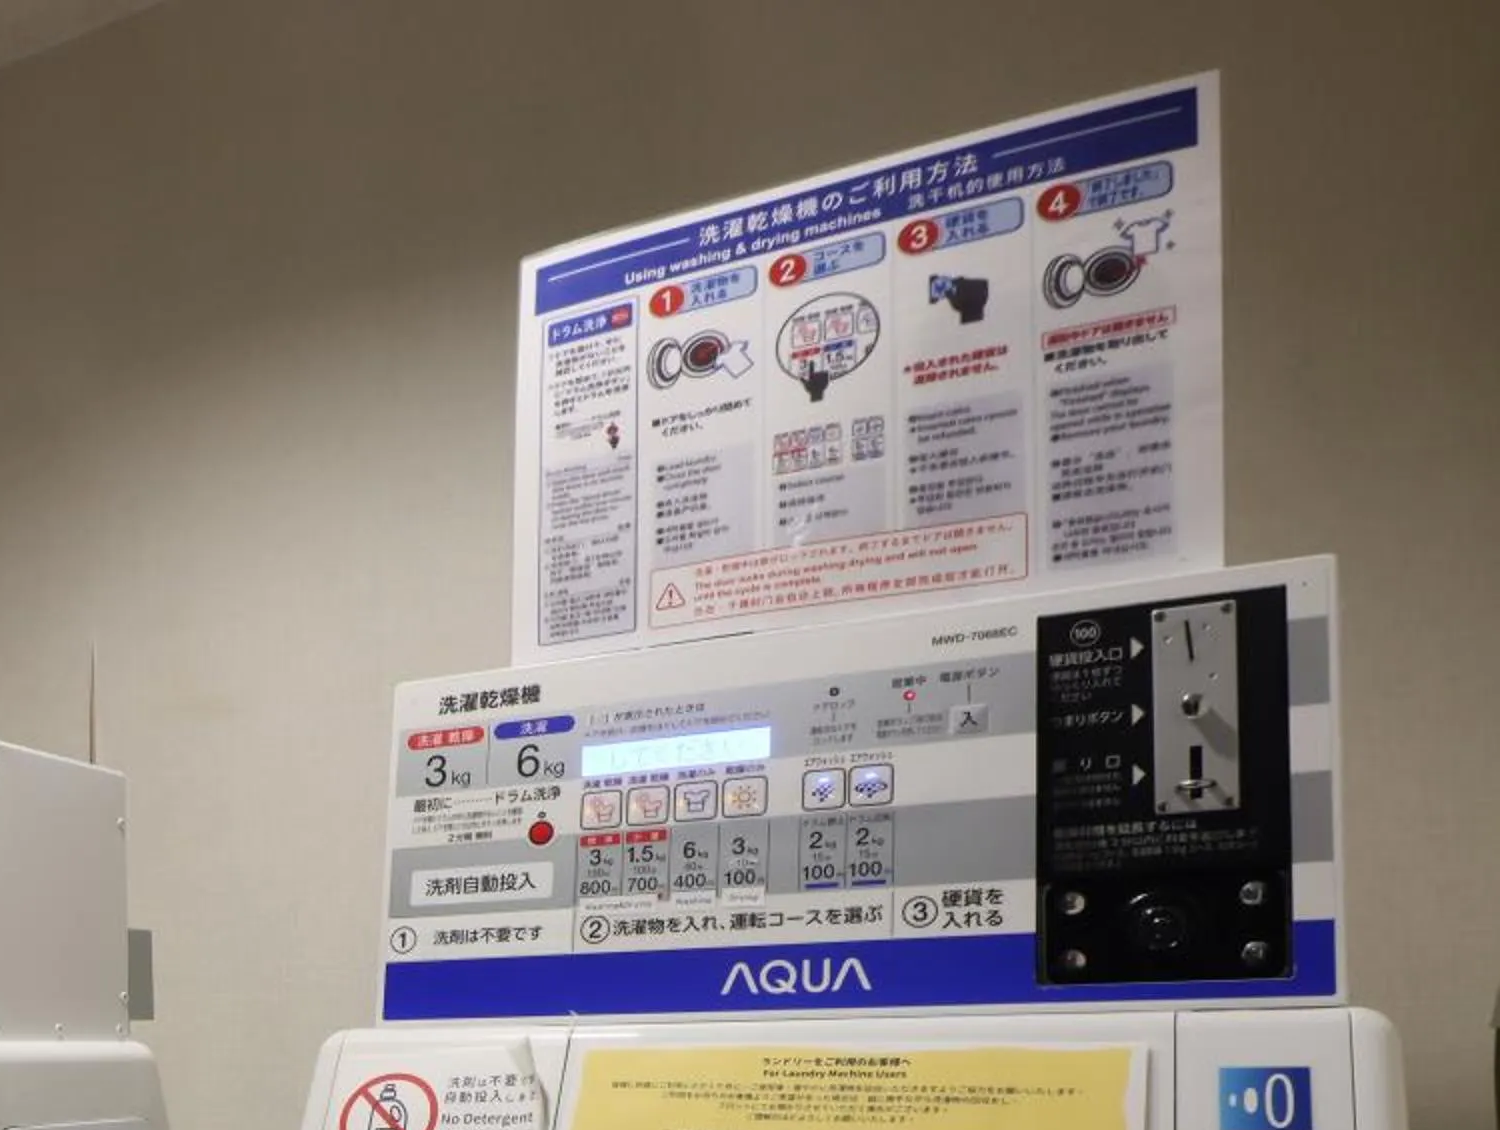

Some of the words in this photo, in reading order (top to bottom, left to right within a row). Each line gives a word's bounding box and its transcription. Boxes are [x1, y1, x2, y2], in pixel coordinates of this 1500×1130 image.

[697, 154, 978, 246] 洗濯乾燥機のご利用方法
[624, 266, 665, 284] Using
[669, 248, 731, 273] washing
[735, 242, 746, 254] &
[752, 229, 800, 251] drying
[804, 208, 881, 236] machines
[438, 684, 541, 716] 洗濯乾燥機
[519, 720, 548, 735] 洗濯
[959, 711, 979, 728] 入
[495, 785, 561, 806] ドラム洗浄
[425, 872, 536, 897] 洗剤自動投入
[942, 888, 1003, 908] 硬貨を
[613, 904, 884, 937] 洗濯物を入れ、運転コースを選ぶ
[942, 910, 1003, 930] 入れる
[433, 925, 543, 945] 洗剤は不要です
[720, 957, 872, 995] AQUA
[783, 1069, 826, 1079] Laundry
[828, 1069, 873, 1078] Machine
[876, 1070, 908, 1078] Users
[441, 1112, 461, 1124] No
[463, 1111, 534, 1127] Detergent
